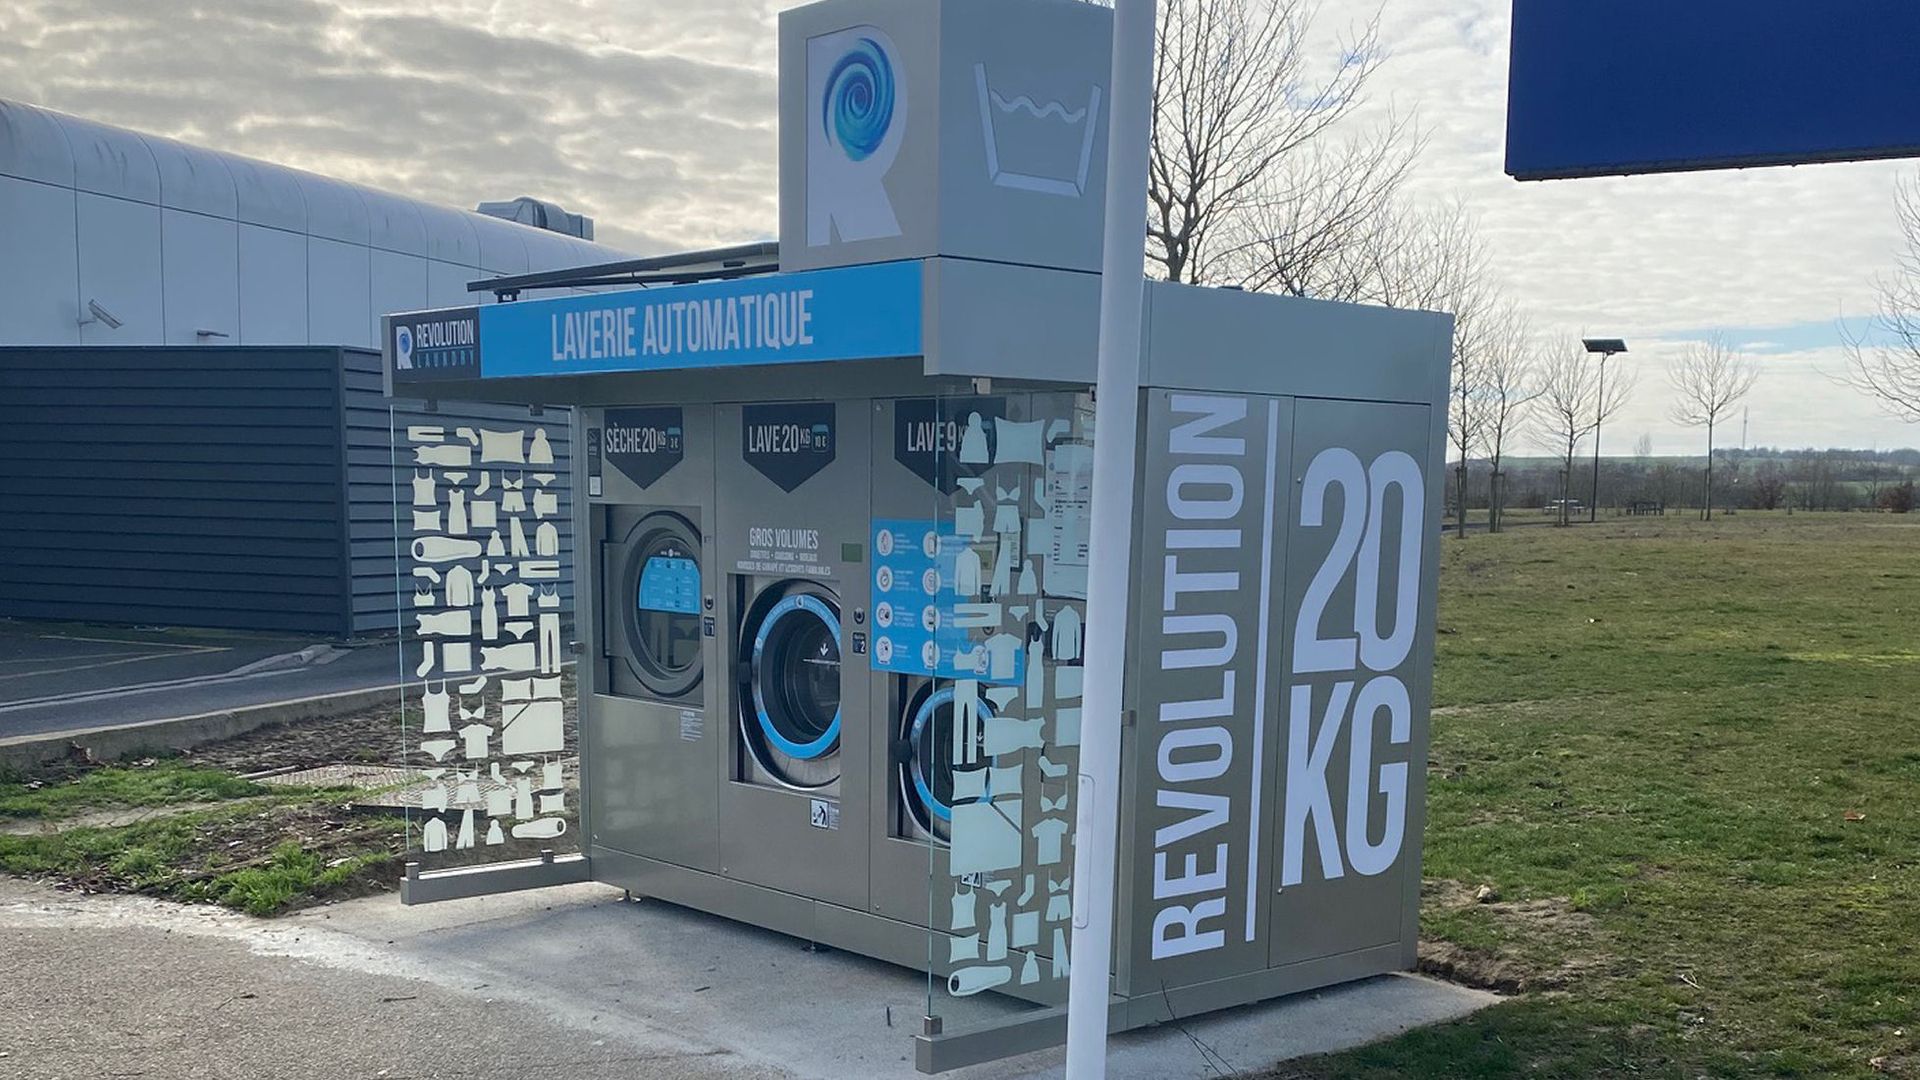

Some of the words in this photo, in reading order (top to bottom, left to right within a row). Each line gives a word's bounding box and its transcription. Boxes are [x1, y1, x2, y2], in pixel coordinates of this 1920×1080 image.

[806, 24, 908, 247] R
[416, 319, 474, 348] REVOLUTION
[416, 350, 474, 369] LAUNDRY
[551, 305, 636, 361] LAVERIE
[643, 288, 814, 355] AUTOMATIQUE
[749, 527, 773, 547] GROS
[775, 528, 819, 549] VOLUMES
[1292, 447, 1426, 674] 20
[1151, 394, 1248, 960] REVOLUTION
[1282, 675, 1412, 887] KG
